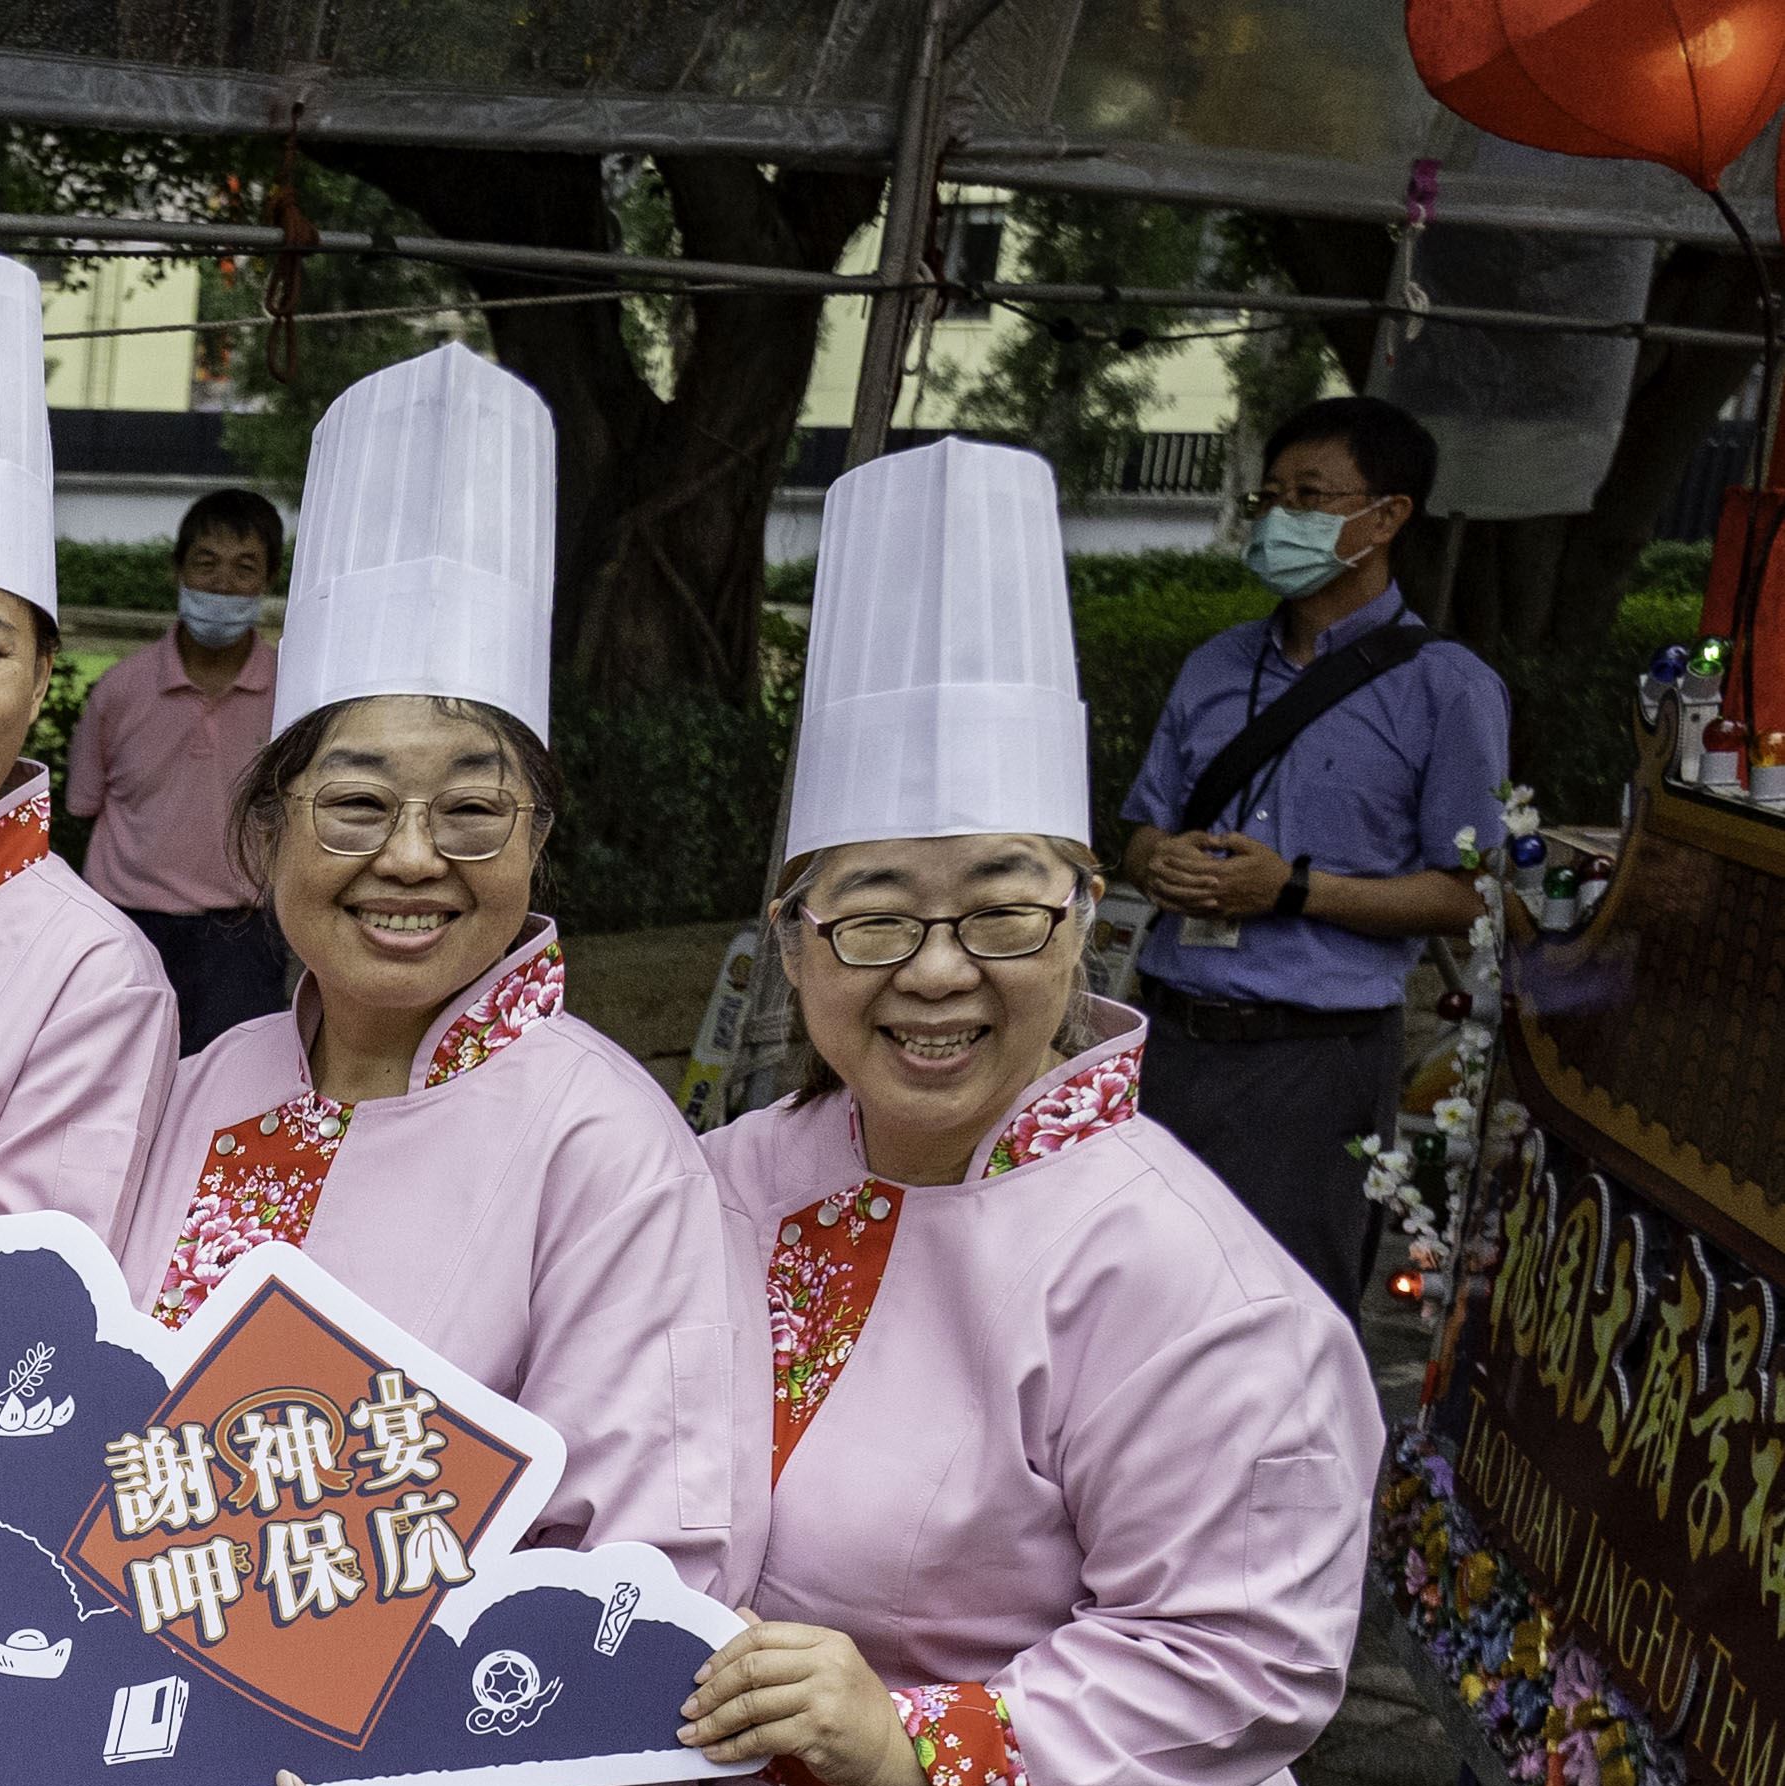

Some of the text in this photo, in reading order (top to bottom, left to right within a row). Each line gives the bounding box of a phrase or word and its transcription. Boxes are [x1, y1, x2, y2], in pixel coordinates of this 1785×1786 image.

[103, 1368, 447, 1537] 謝神宴
[1459, 1385, 1578, 1587] TAOYUAN
[1564, 1511, 1695, 1713] JINGFU
